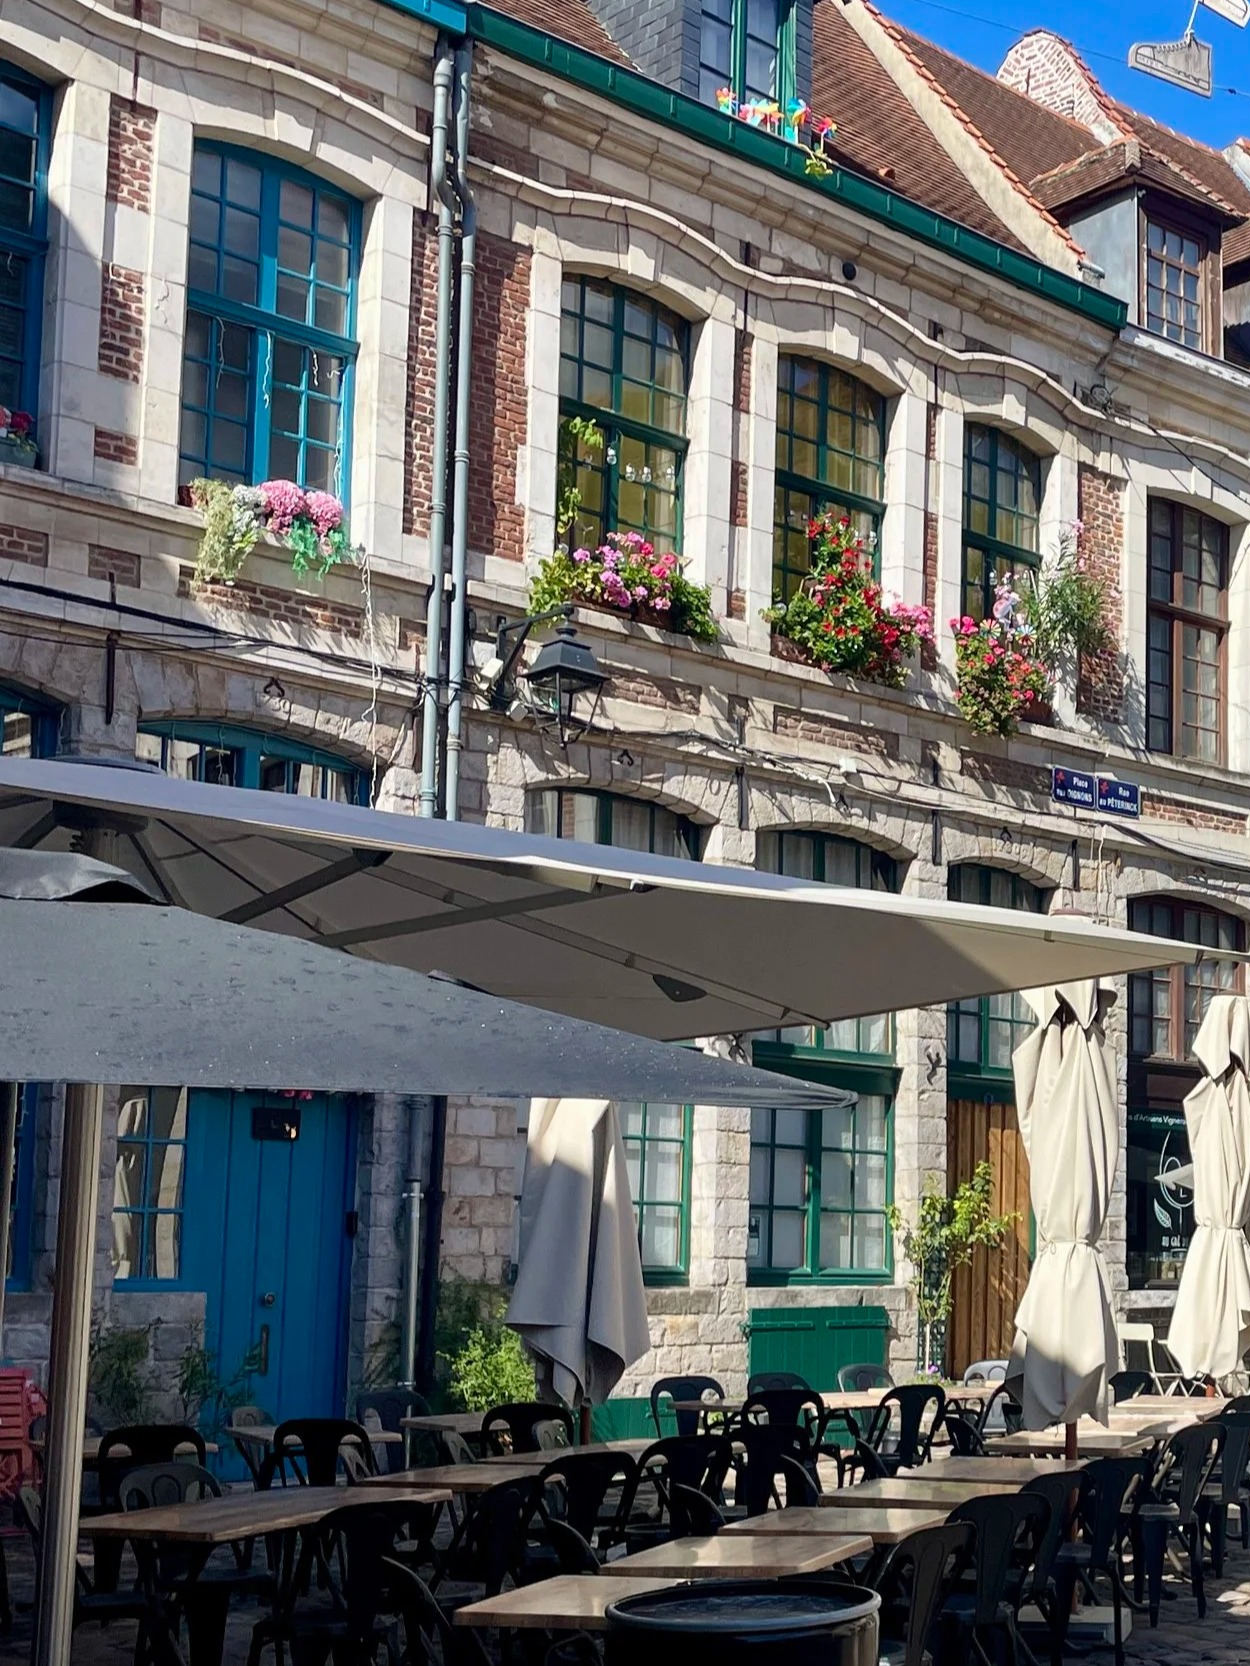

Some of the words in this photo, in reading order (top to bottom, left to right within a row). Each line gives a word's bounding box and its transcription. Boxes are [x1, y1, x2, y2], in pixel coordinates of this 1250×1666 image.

[1073, 777, 1088, 788] Place
[1067, 788, 1092, 802] OIGNONS
[1118, 787, 1130, 797] Rue
[1163, 1115, 1186, 1126] Vignero
